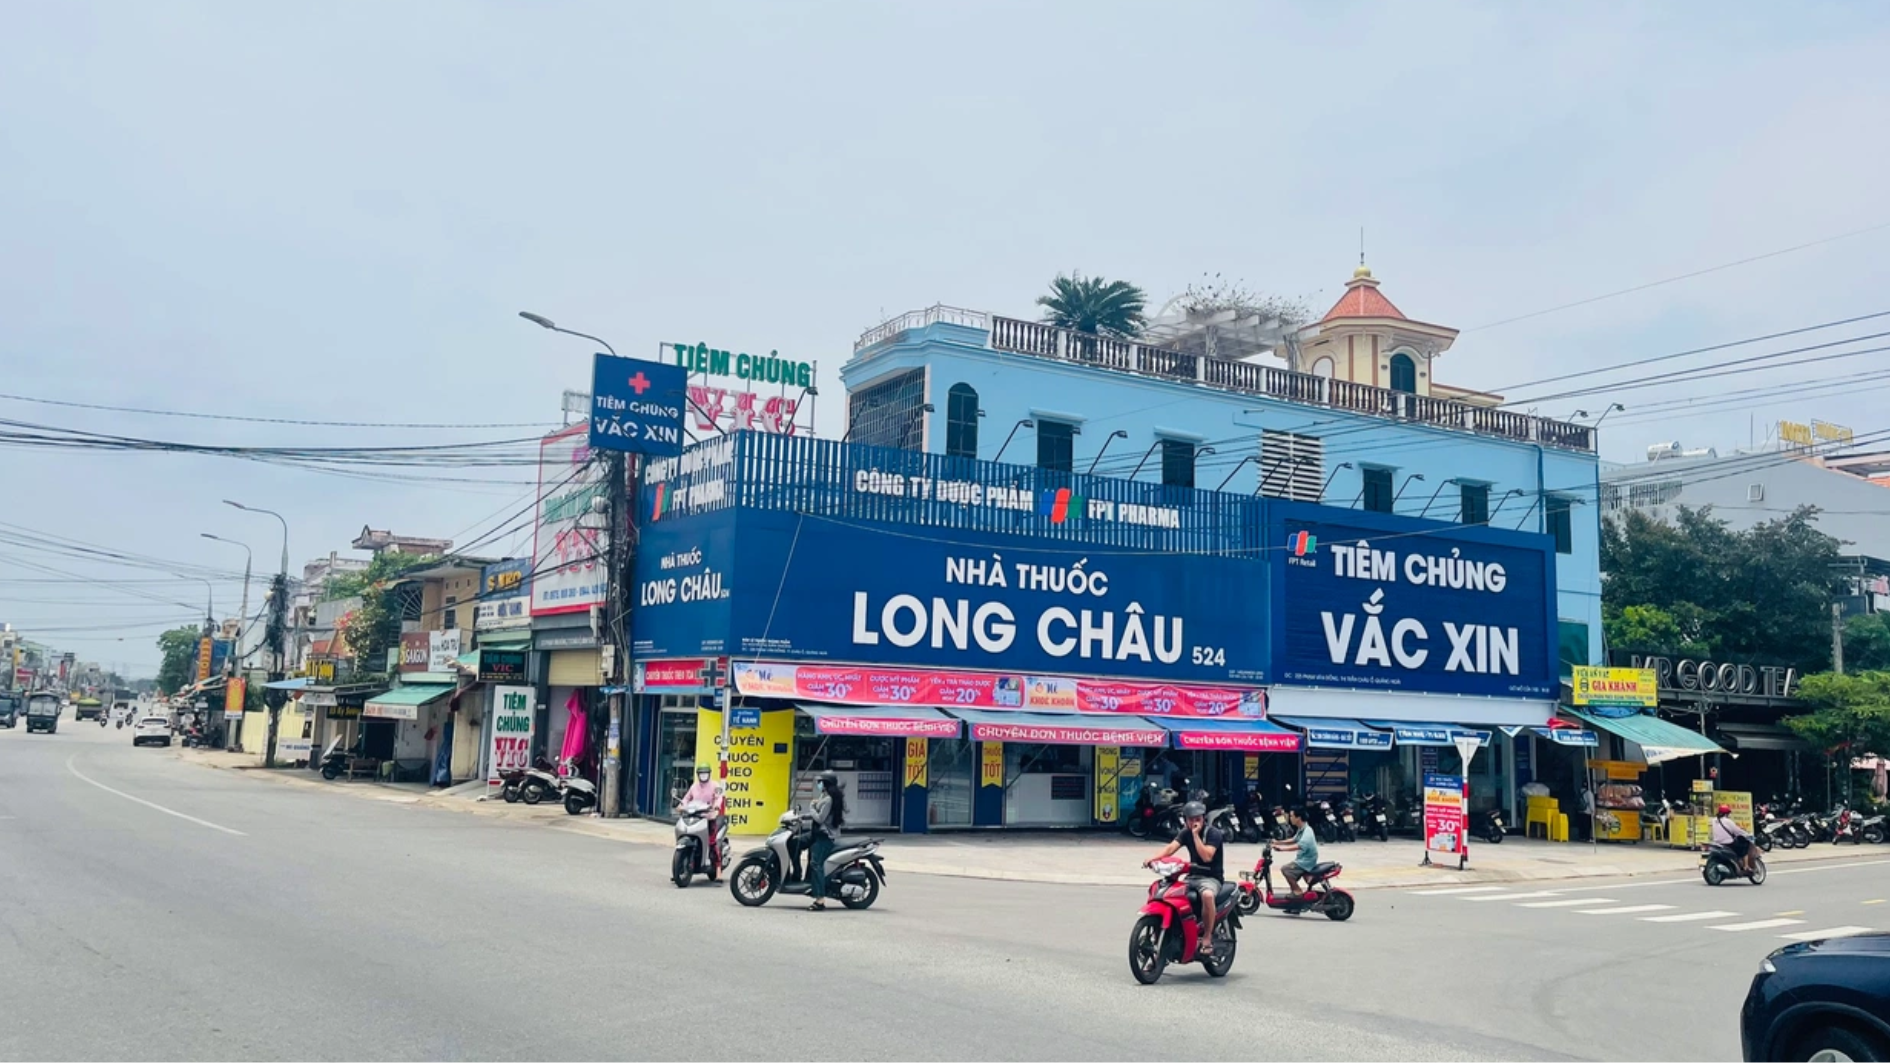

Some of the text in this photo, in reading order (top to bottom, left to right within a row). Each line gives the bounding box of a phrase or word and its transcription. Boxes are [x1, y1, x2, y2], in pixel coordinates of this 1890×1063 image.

[673, 341, 810, 388] TIÊM CHỦNG
[596, 395, 626, 411] TIÊM
[644, 423, 678, 444] XIN
[855, 467, 1180, 528] CÔNG TY DƯỢC PHẨM FPT PHARMA
[661, 546, 702, 570] NHÀ THUỐC
[1288, 557, 1299, 566] FPT
[1330, 540, 1506, 593] TIÊM CHỦNG
[945, 553, 1109, 597] NHÀ THUỐC
[641, 578, 676, 607] LONG
[680, 567, 721, 602] CHÂU
[852, 591, 1226, 667] LONG CHÂU 524
[1320, 587, 1519, 676] VẮC XIN
[1592, 680, 1606, 691] GIA
[1607, 678, 1636, 692] KHÁNH
[1677, 659, 1757, 696] GOOD
[1760, 665, 1799, 697] TEA
[503, 691, 526, 711] TIÊM
[890, 685, 917, 701] 30%
[955, 687, 982, 703] 20%
[496, 711, 530, 732] CHỦNG
[714, 734, 765, 747] CUYÊN
[977, 725, 1163, 745] CHUYÊN ĐƠN THUỐC BỆNH VIỆN
[1184, 735, 1297, 749] CHUYÊN ĐƠN THUỐC BỆNH VIỆN
[907, 739, 926, 758] GIÁ
[718, 767, 753, 778] HEO
[906, 760, 925, 780] TỐT
[983, 760, 1001, 779] TỐT
